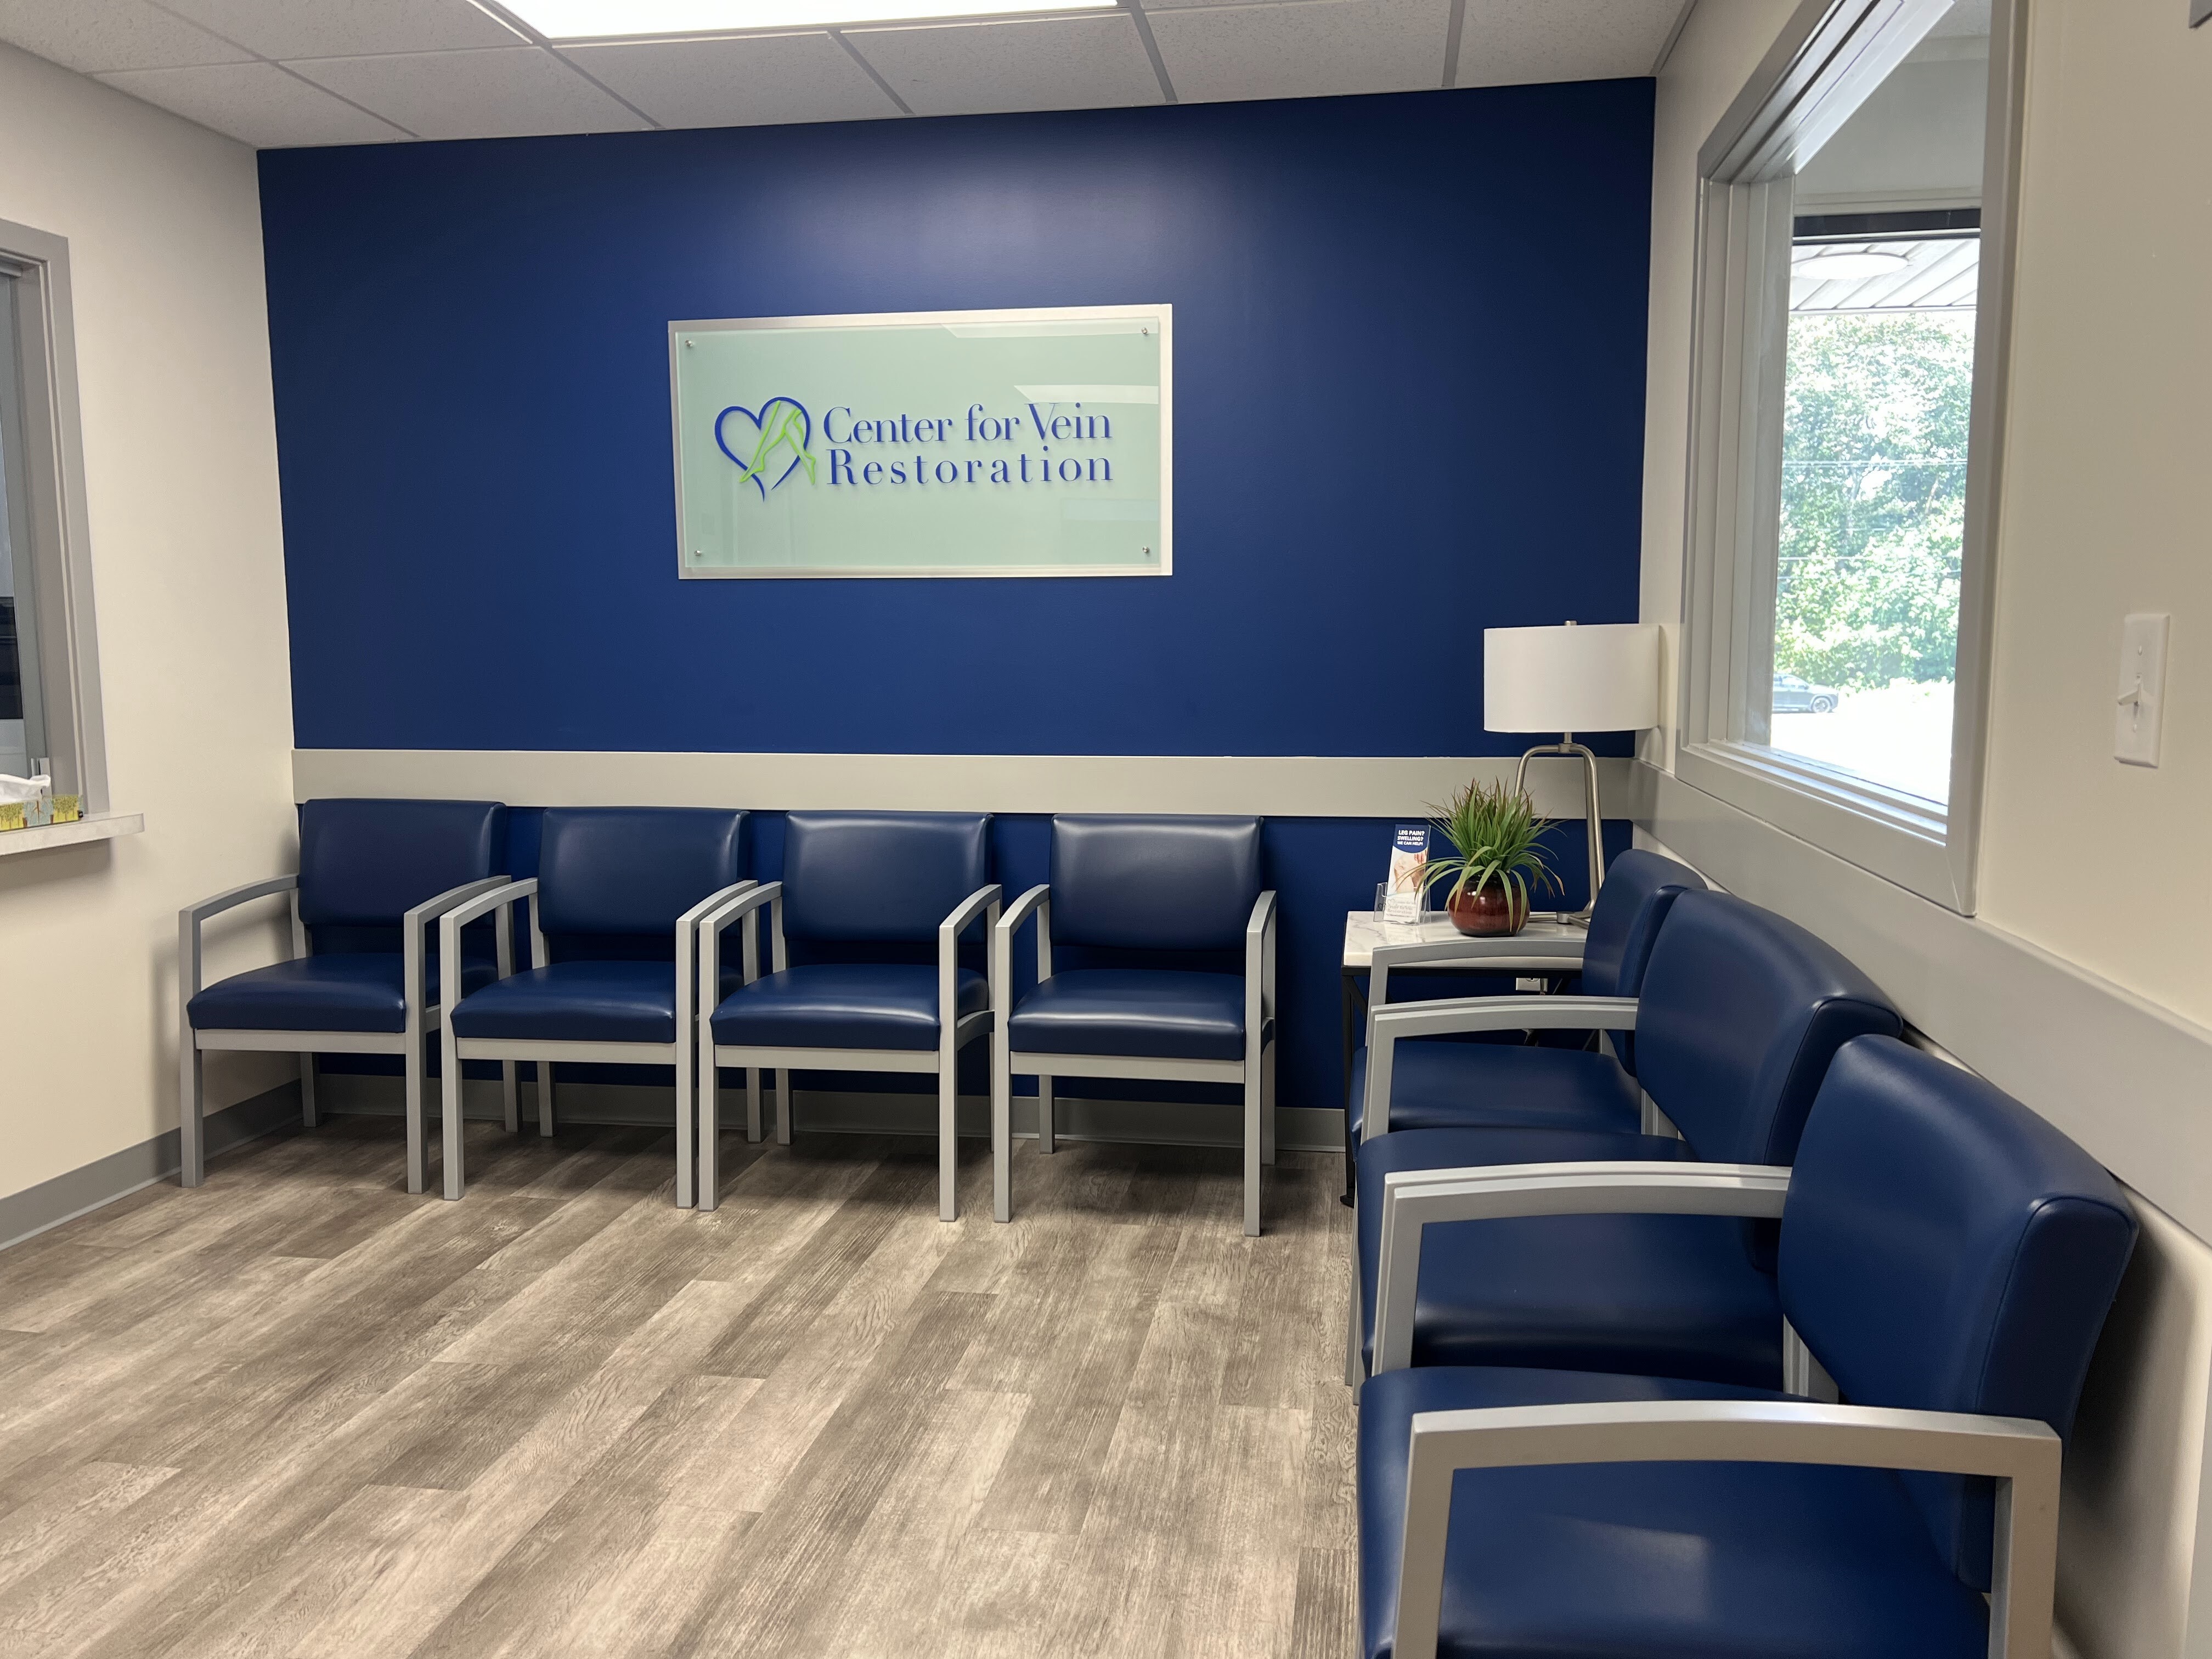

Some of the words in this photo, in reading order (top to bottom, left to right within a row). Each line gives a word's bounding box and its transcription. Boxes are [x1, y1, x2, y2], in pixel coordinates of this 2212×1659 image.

[823, 406, 952, 443] Center
[966, 403, 1020, 441] for
[1025, 402, 1113, 441] Vein
[827, 445, 1114, 486] Restoration
